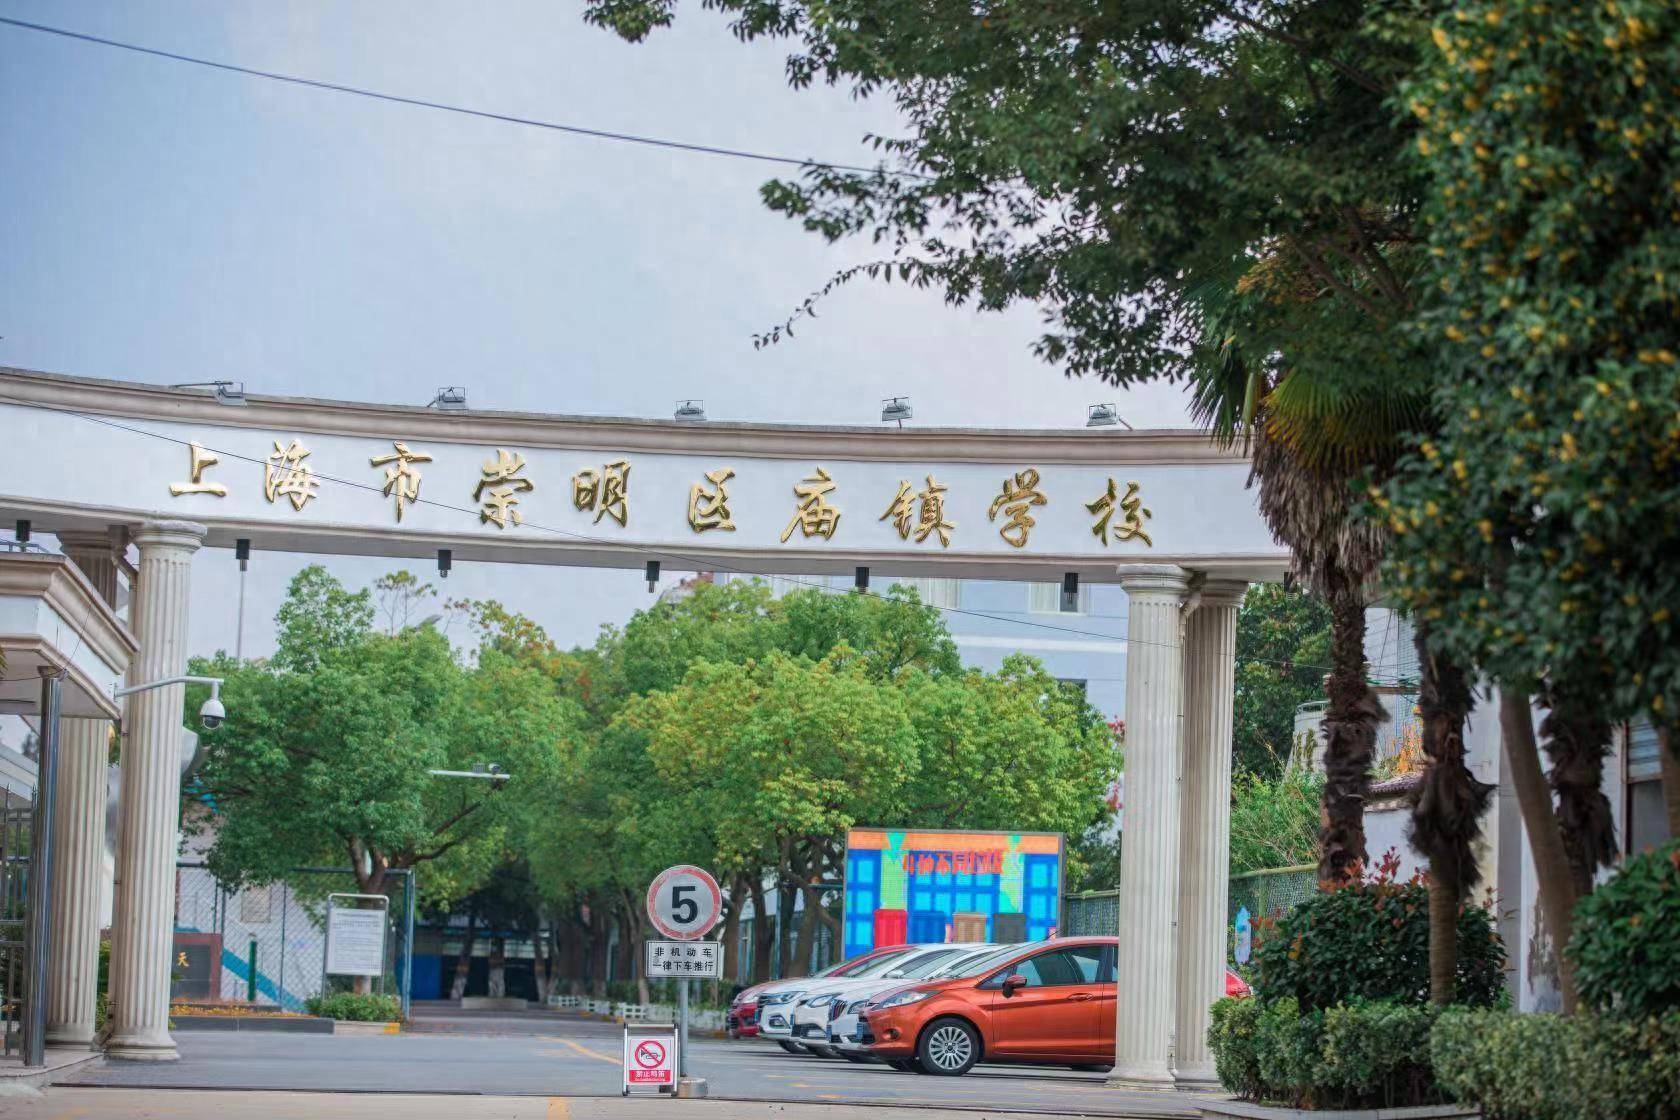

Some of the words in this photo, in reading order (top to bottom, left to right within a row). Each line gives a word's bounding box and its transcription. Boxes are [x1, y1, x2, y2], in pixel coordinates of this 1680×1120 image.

[169, 438, 1153, 548] 上海市崇明区庙镇学校
[671, 885, 698, 923] 5
[654, 946, 712, 957] 非机动车
[652, 960, 714, 971] 一律下车推行
